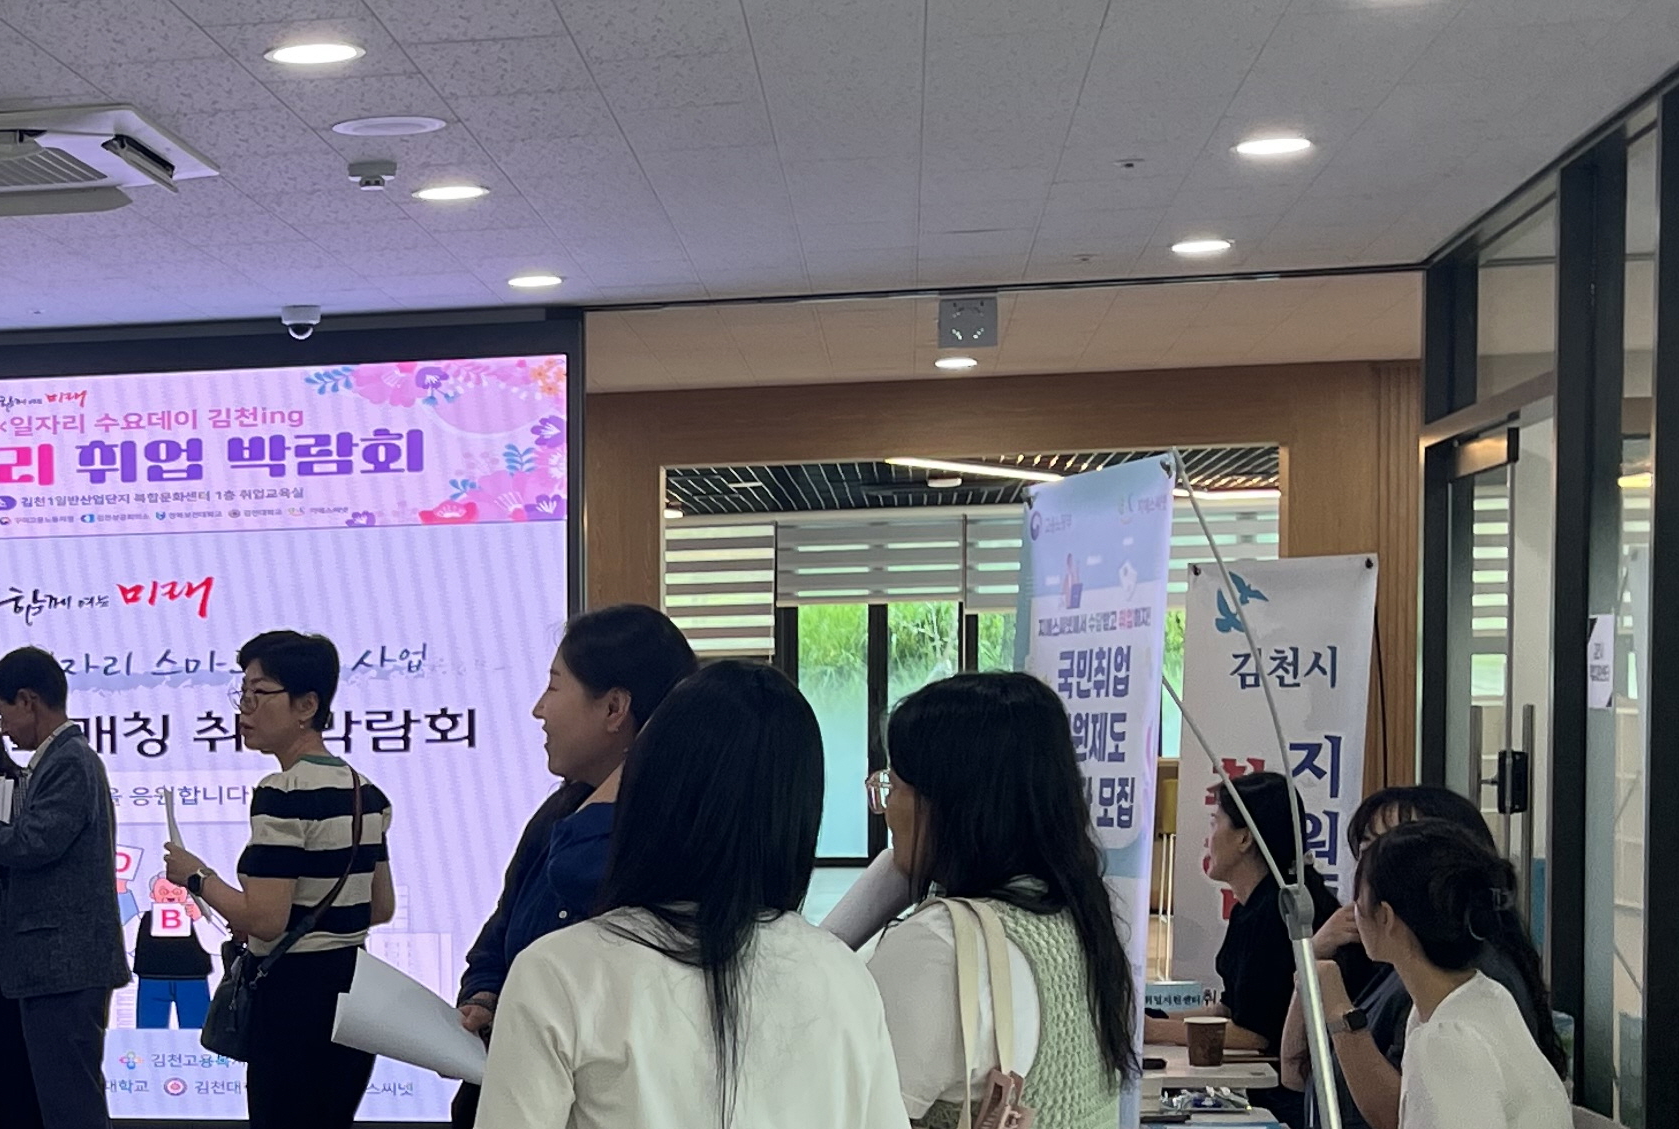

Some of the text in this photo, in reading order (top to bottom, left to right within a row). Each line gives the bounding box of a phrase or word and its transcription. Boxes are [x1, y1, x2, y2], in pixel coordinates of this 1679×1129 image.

[45, 390, 88, 408] 미래
[94, 408, 198, 435] 수요데이
[208, 406, 304, 430] 김천ing
[75, 438, 204, 484] 취업
[226, 428, 424, 478] 박람회
[215, 489, 236, 501] 1층
[239, 487, 304, 500] 취업교육실
[116, 576, 214, 619] 미래
[58, 651, 133, 676] 자리
[351, 645, 427, 673] 사업
[1058, 645, 1131, 699] 국민취업
[1229, 646, 1338, 689] 김천시
[1067, 711, 1127, 763] 원제도
[1096, 776, 1135, 829] 모집
[161, 909, 182, 930] B
[194, 1079, 248, 1095] 김천대
